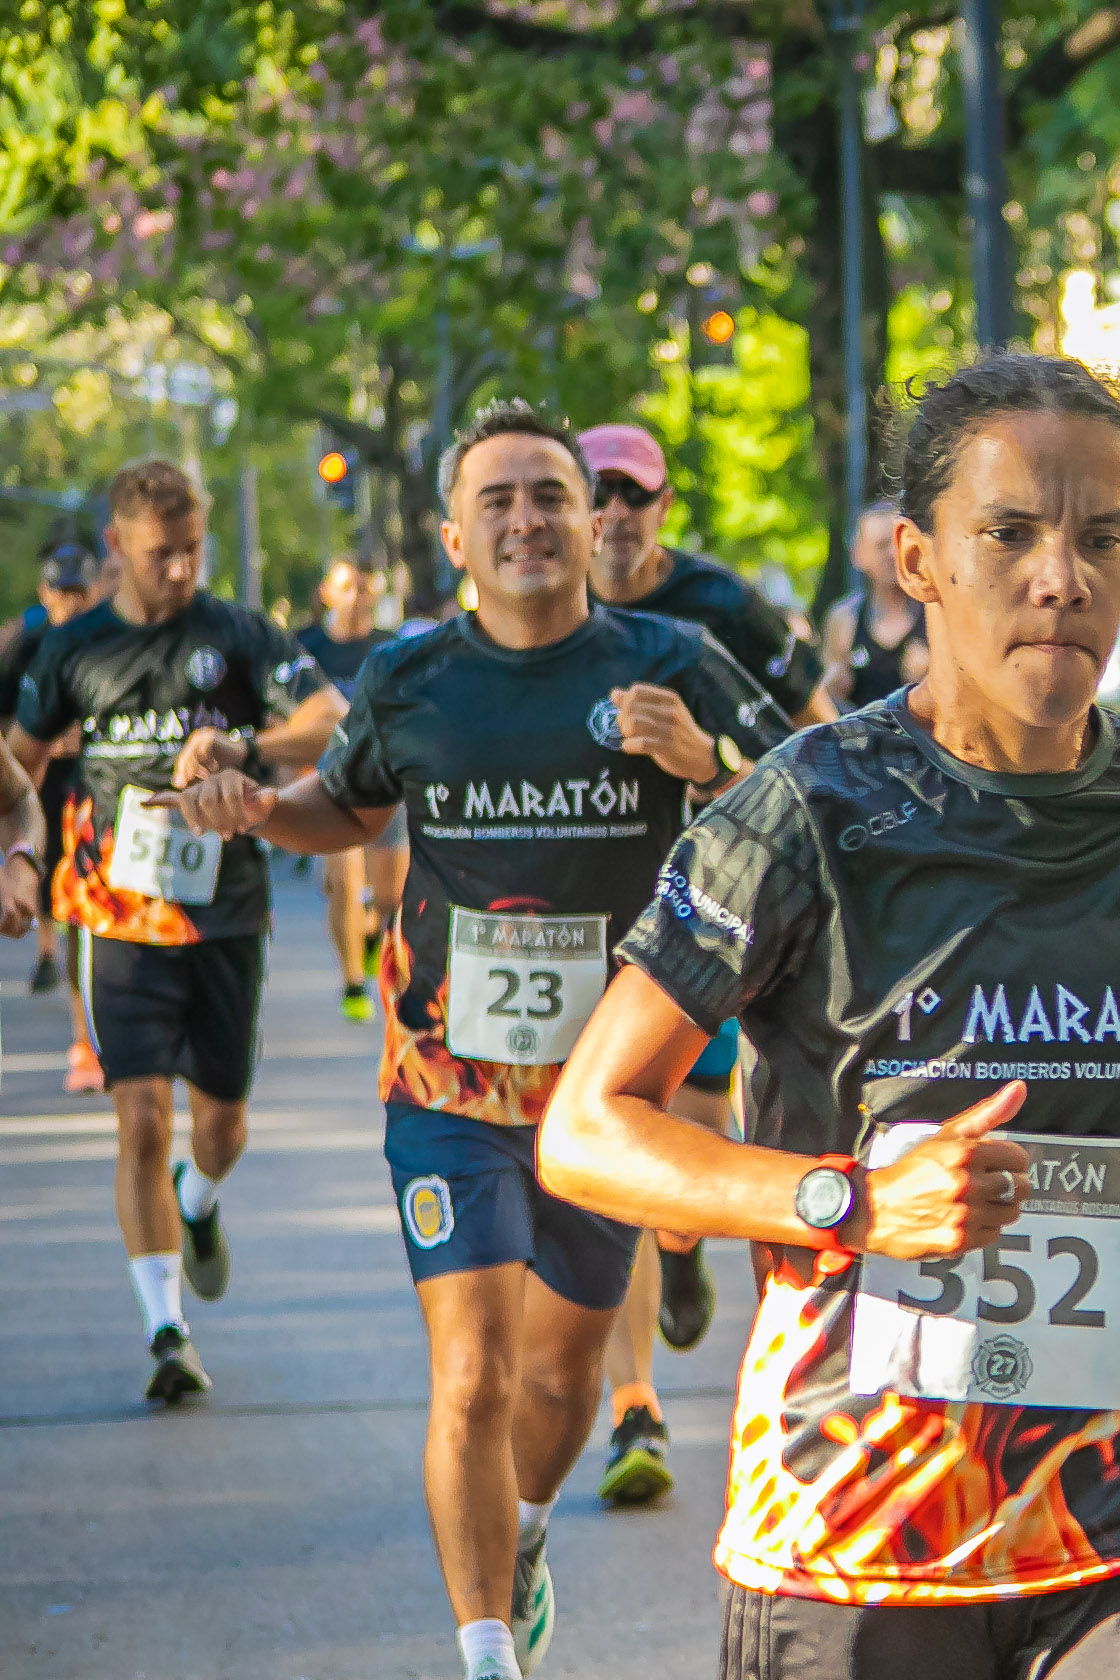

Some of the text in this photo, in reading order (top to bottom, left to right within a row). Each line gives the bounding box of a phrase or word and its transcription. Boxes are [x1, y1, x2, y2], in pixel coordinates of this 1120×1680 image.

[464, 768, 640, 819] MARATÓN
[129, 829, 206, 872] 510
[492, 924, 585, 948] MARATÓN
[486, 968, 563, 1020] 23
[864, 1059, 971, 1080] ASOCIACIÓN
[974, 1061, 1071, 1080] BOMBEROS
[1028, 1151, 1106, 1194] ATÓN
[897, 1234, 1106, 1328] 352
[991, 1354, 1016, 1376] 27
